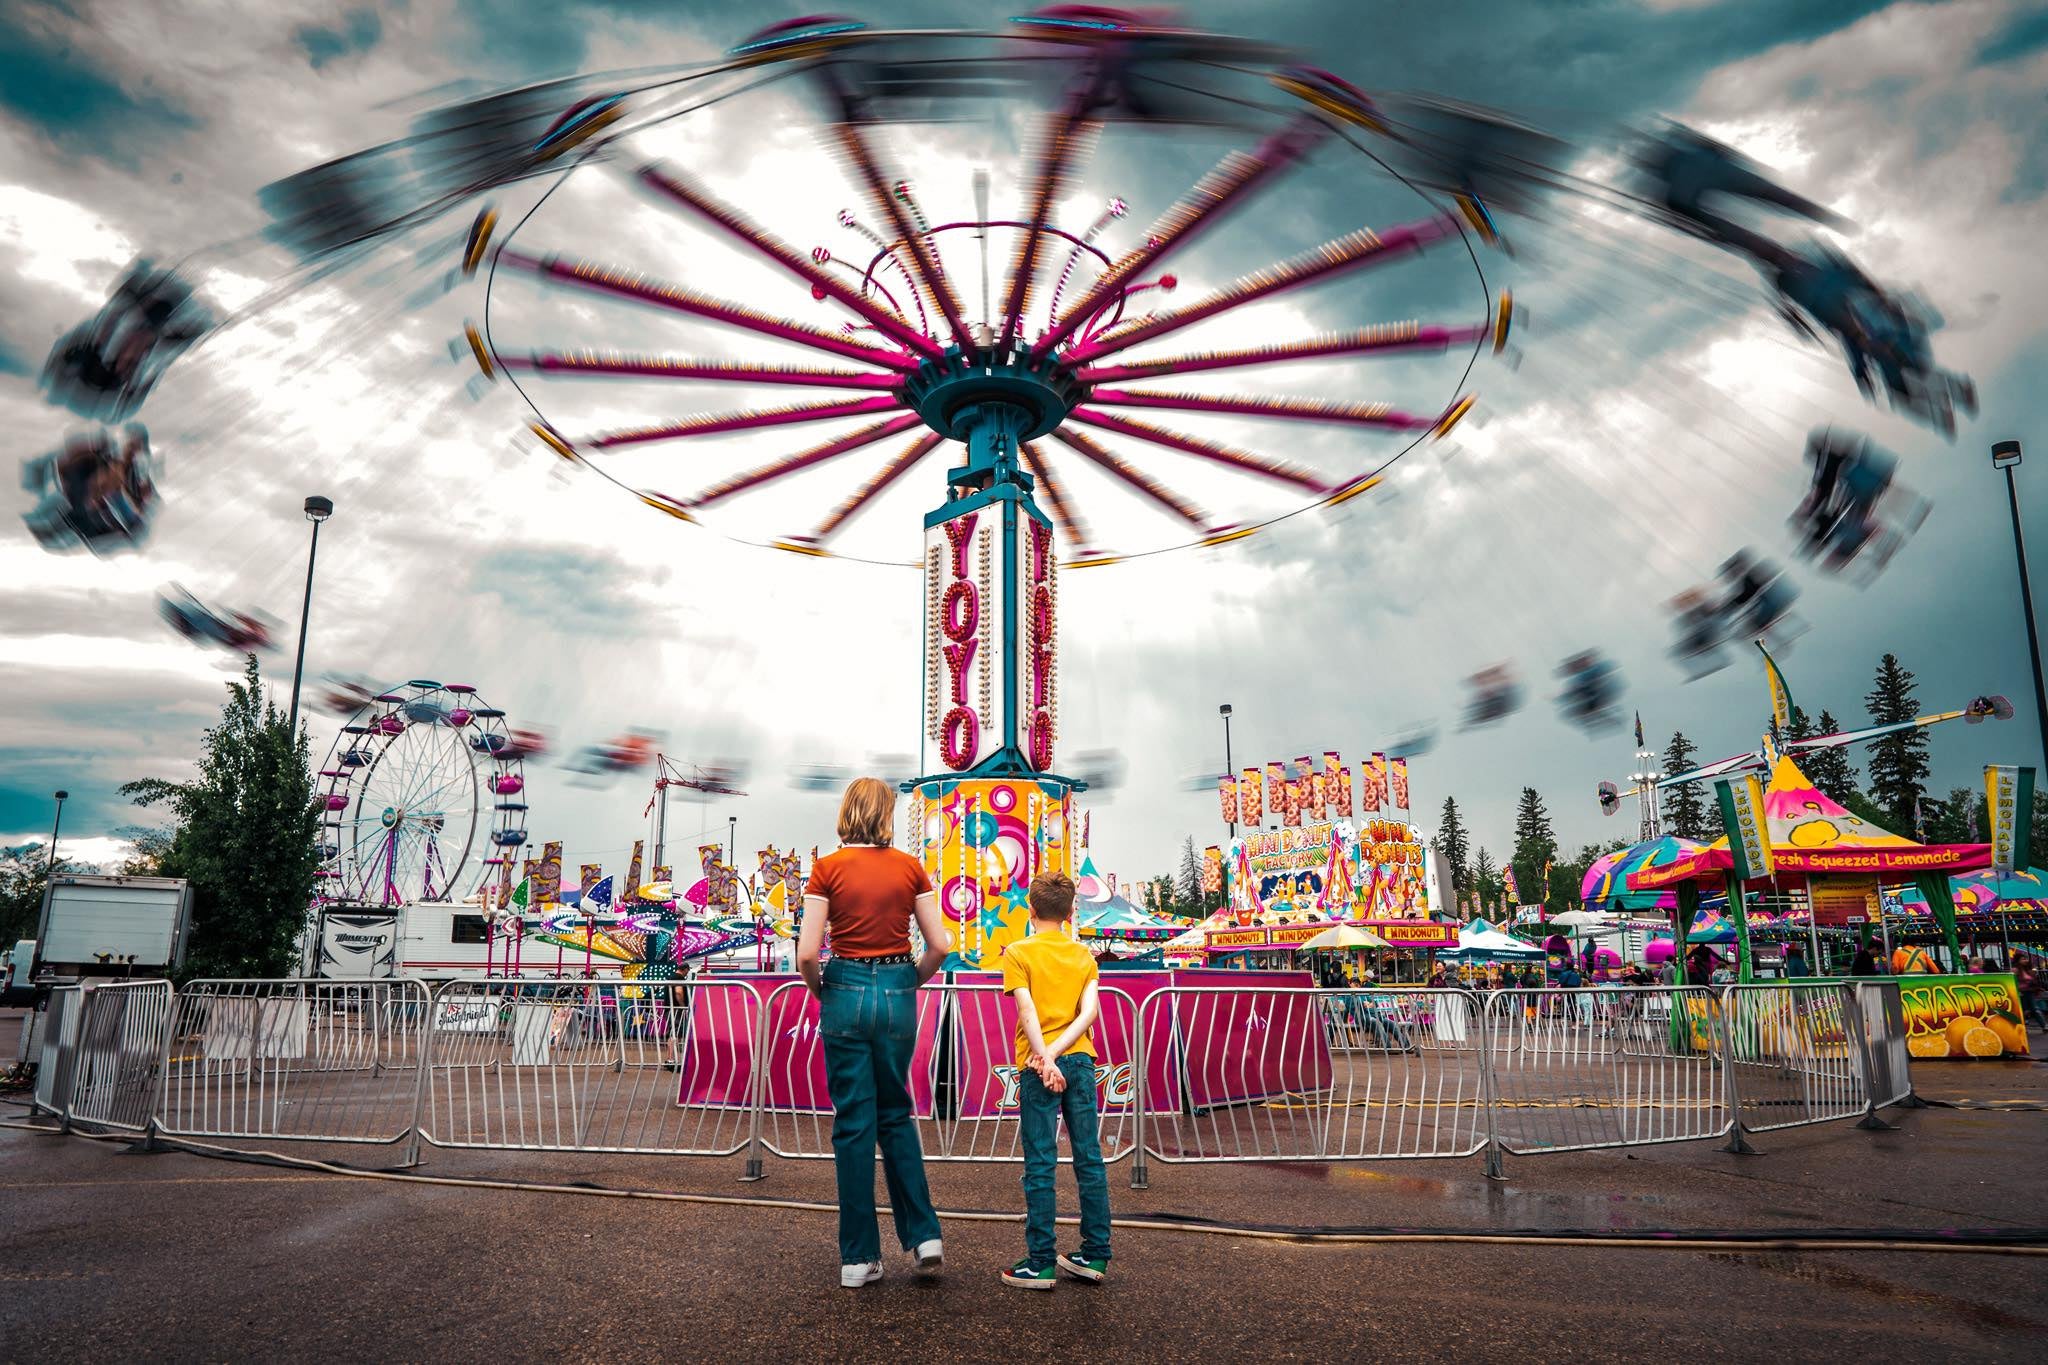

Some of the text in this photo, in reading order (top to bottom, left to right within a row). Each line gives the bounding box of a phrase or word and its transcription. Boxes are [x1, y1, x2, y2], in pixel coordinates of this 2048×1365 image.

[1369, 819, 1409, 844] MINI
[1733, 785, 1763, 871] LEMONADE
[1998, 776, 2013, 864] LEMONADE
[1246, 821, 1333, 858] MINI DONUT
[1264, 852, 1314, 869] FACTORY
[1360, 841, 1423, 866] DONUTS
[1772, 850, 1961, 870] resh Squeezed Lemonade
[1216, 932, 1260, 944] MINI DONUTS
[1278, 931, 1296, 942] MINI
[1391, 927, 1409, 938] MINI
[1410, 927, 1440, 938] DONUTS
[1901, 984, 2012, 1037] NADE
